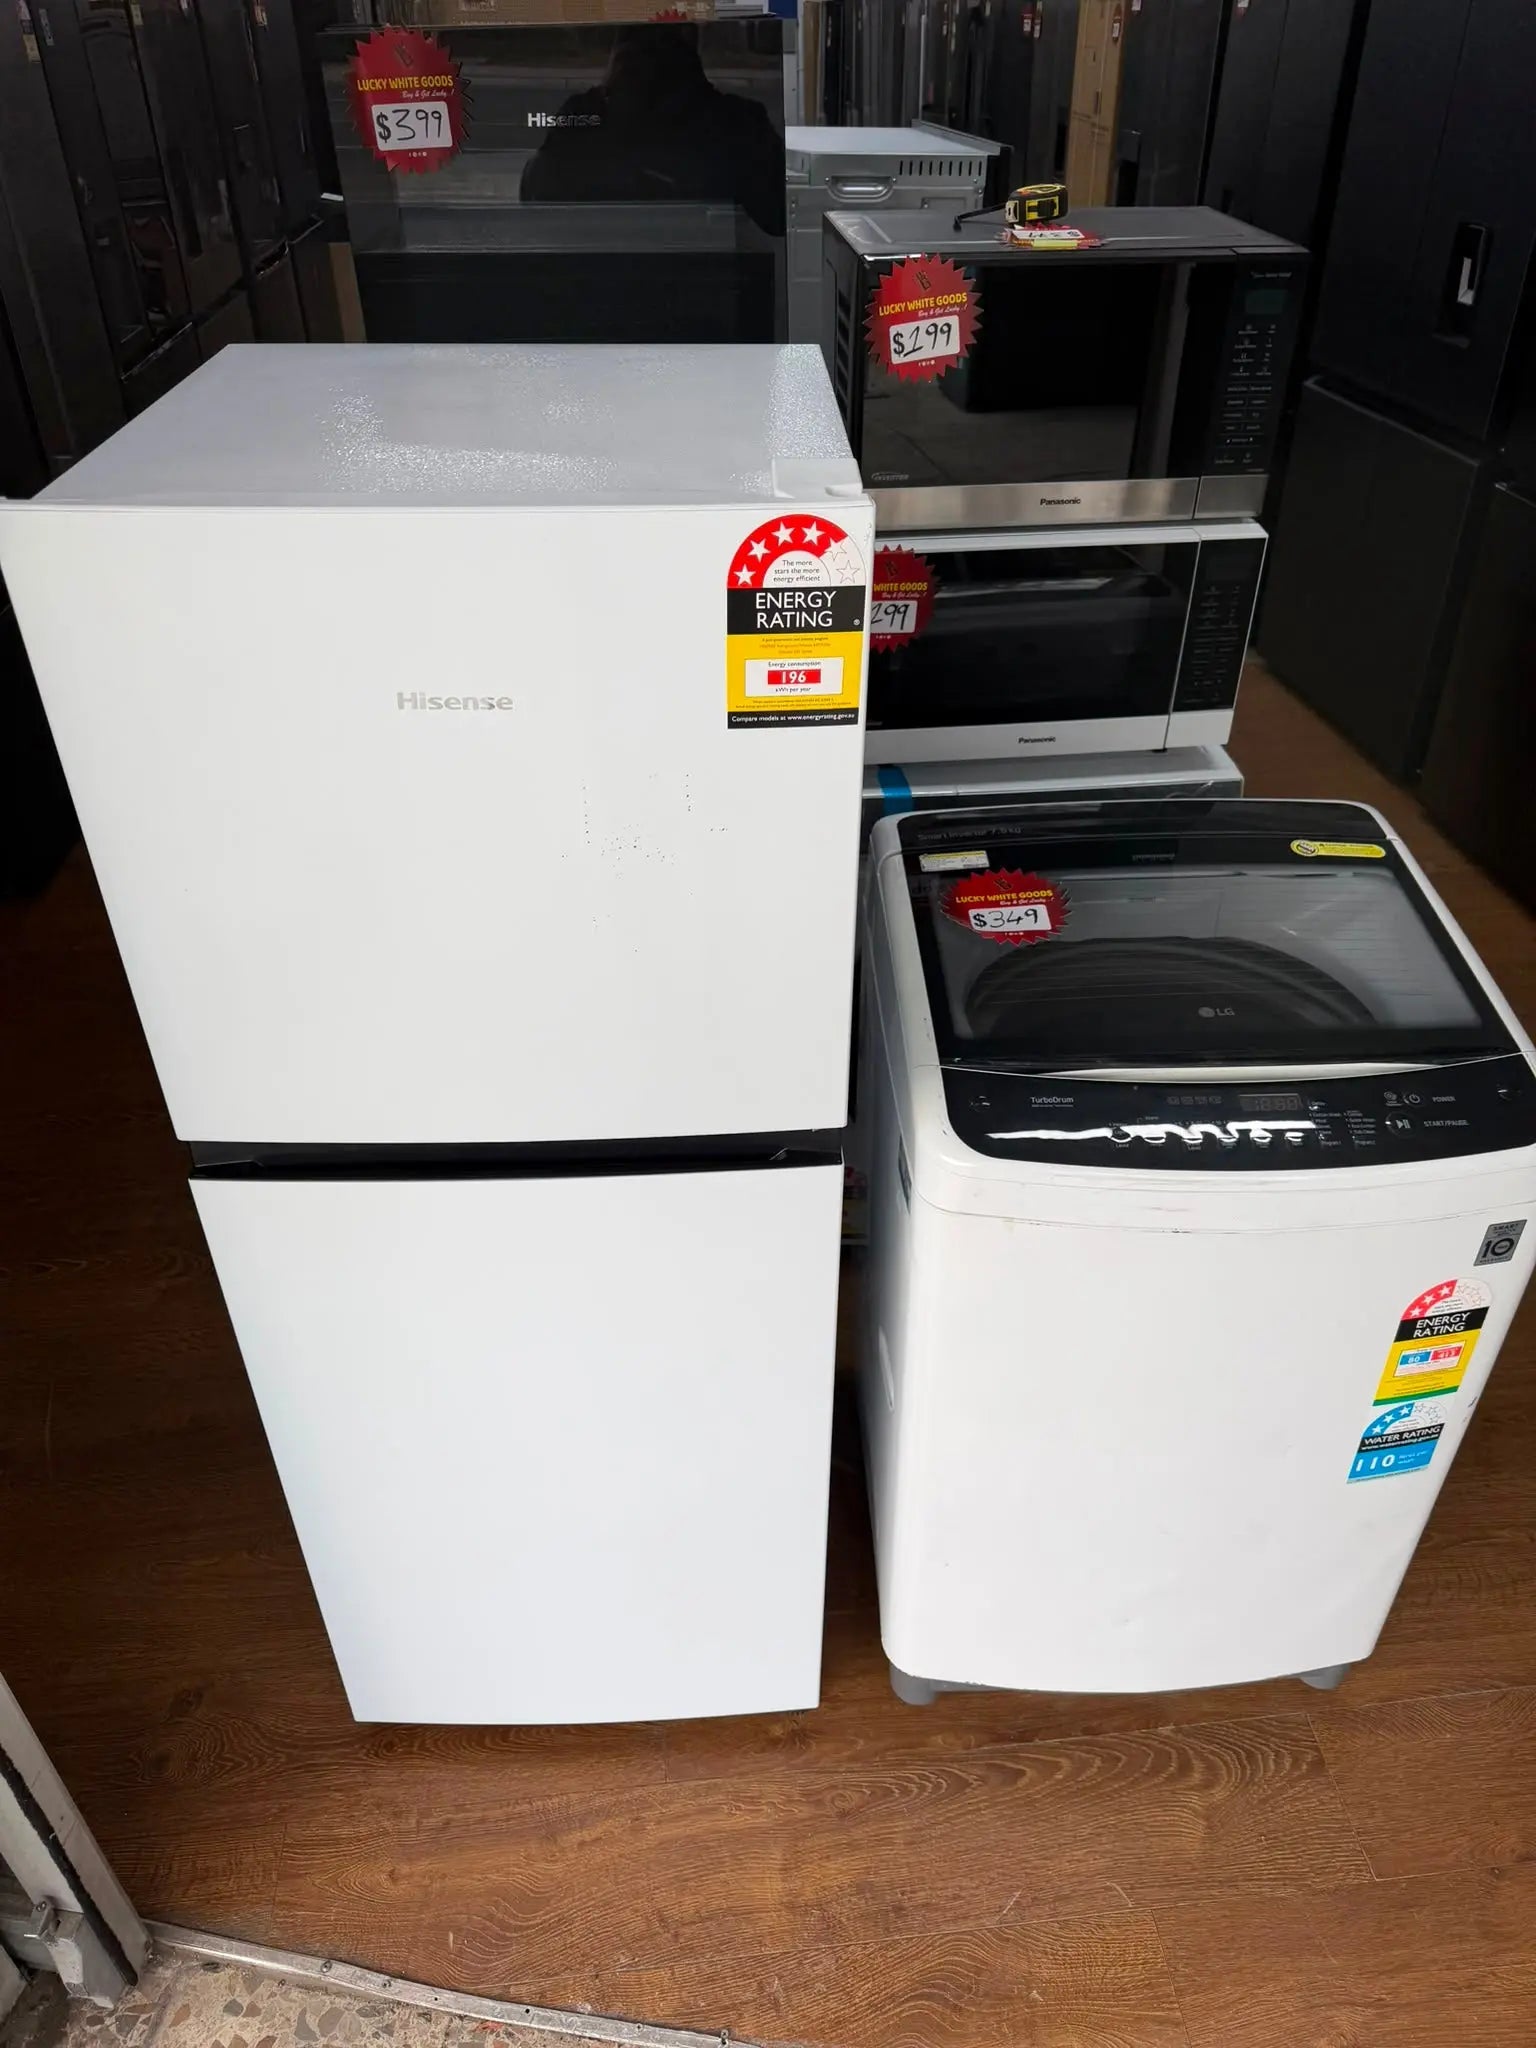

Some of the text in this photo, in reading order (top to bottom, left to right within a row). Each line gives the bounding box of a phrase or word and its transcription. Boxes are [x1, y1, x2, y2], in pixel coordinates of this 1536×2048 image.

[357, 75, 454, 91] LUCKY WHITE GOODS
[375, 108, 443, 144] $399
[527, 112, 601, 128] Hisense
[878, 292, 968, 317] LUCKY WHITE GOODS
[1040, 498, 1081, 506] Panasonic
[773, 576, 794, 584] energy
[873, 582, 928, 592] WHITE GOODS
[755, 590, 837, 610] ENERGY
[756, 611, 833, 629] RATING
[781, 670, 807, 684] 196
[396, 691, 514, 711] Hisense
[731, 715, 758, 724] Compare
[758, 714, 779, 722] models
[955, 889, 1054, 904] LUCKY WHITE GOODS
[972, 908, 1039, 929] $349
[1216, 1007, 1236, 1016] LG
[1030, 1096, 1075, 1104] TurboDrum
[1431, 1095, 1457, 1103] POWER
[1416, 1311, 1471, 1329] ENERGY
[1412, 1322, 1466, 1339] RATING
[1364, 1426, 1442, 1446] WATER RATING
[1355, 1453, 1396, 1472] 110
